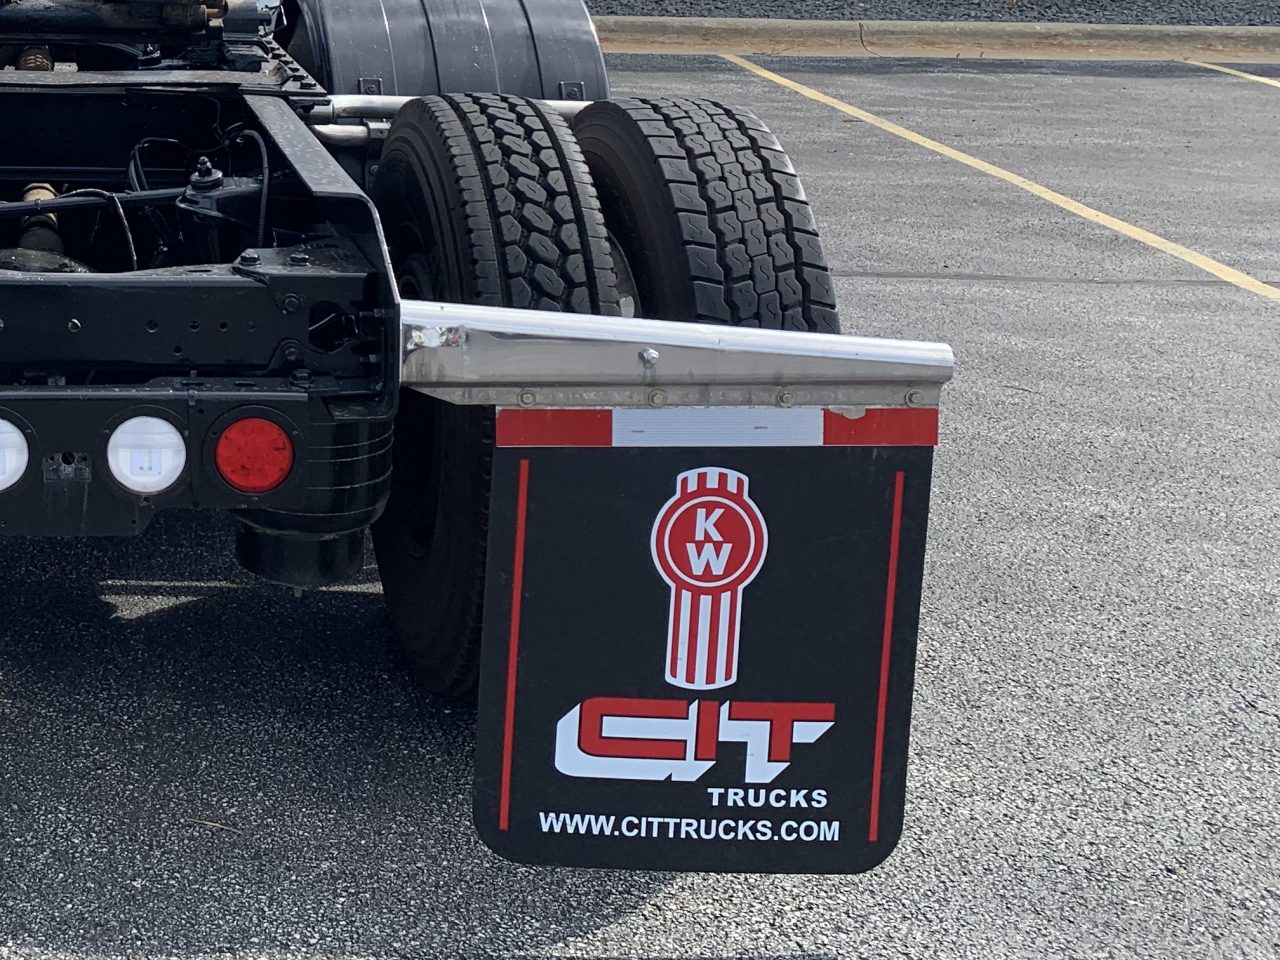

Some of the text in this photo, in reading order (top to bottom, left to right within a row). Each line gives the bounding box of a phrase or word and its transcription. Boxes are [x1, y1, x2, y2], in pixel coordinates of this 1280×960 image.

[554, 697, 835, 783] CIT
[707, 787, 828, 809] TRUCKS
[538, 811, 840, 842] WWW.CITTRUCKS.COM
